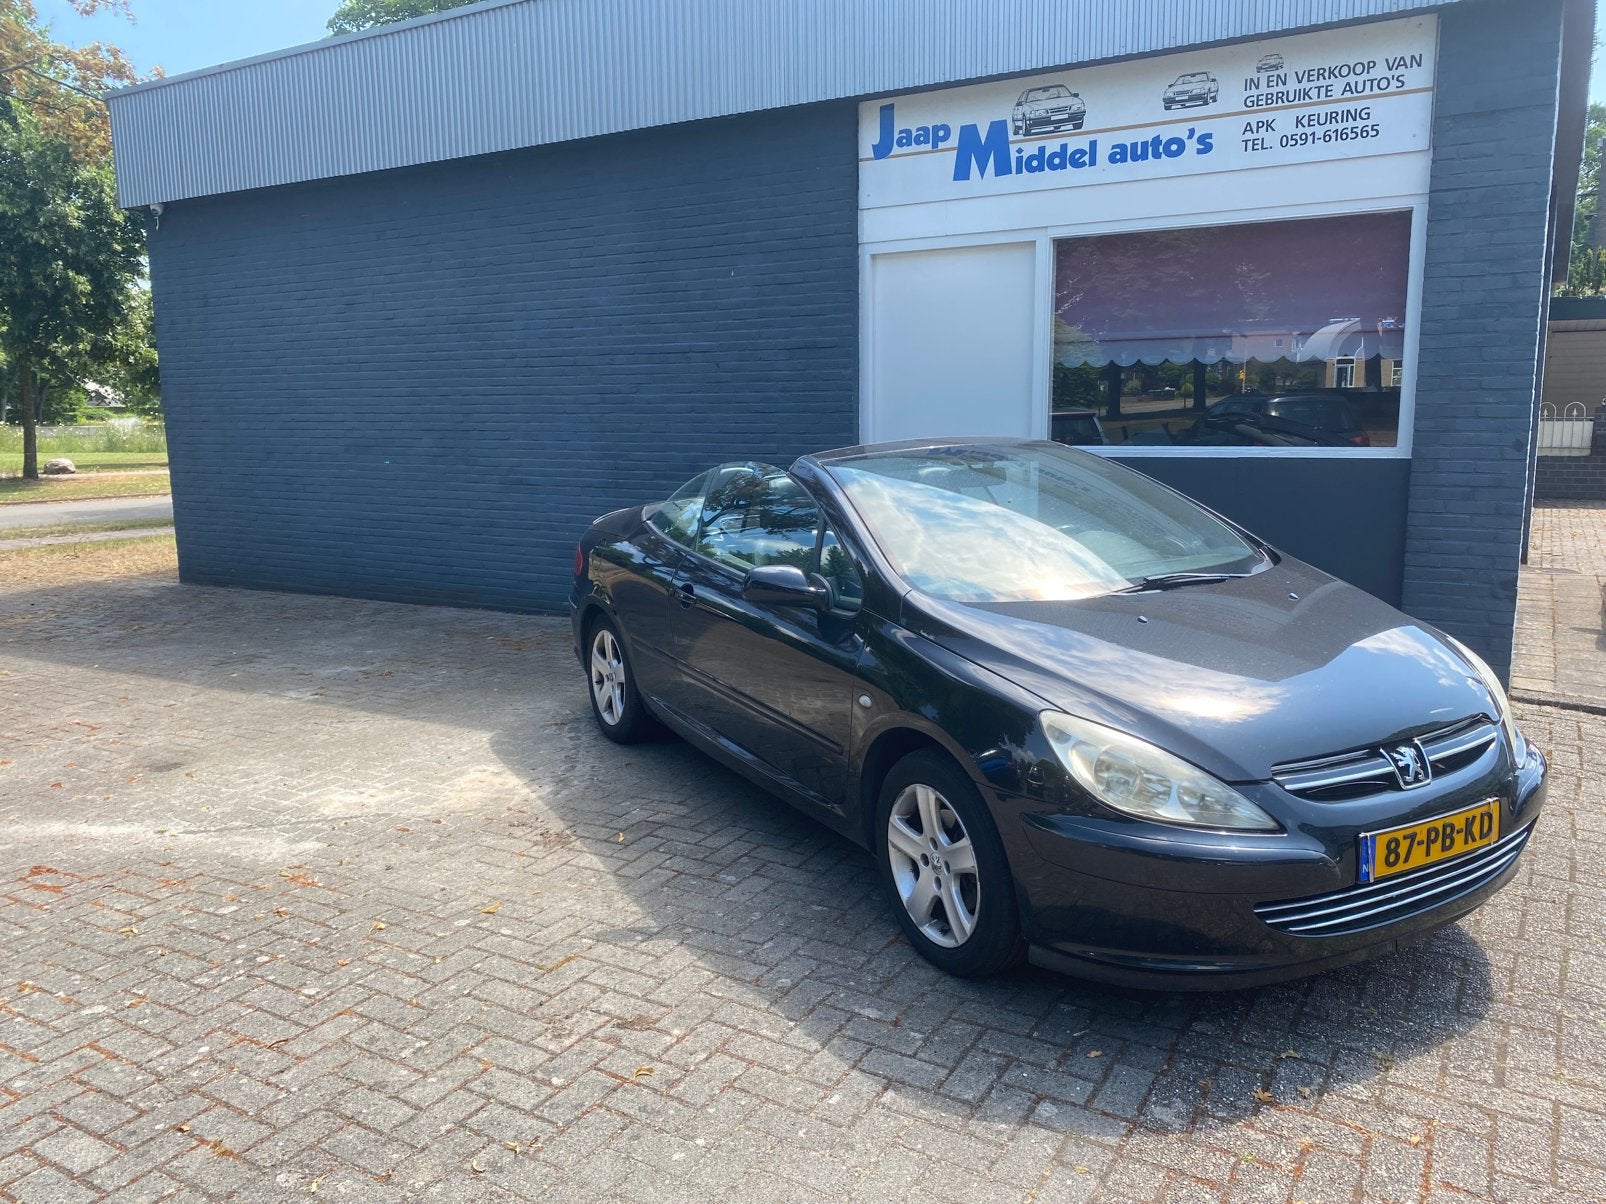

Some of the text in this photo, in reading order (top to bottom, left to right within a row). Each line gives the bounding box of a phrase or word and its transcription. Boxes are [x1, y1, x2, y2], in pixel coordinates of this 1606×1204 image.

[1243, 53, 1424, 92] IN EN VERKOOP VAN
[1243, 74, 1406, 109] GEBRUIKTE AUTO'S
[872, 103, 951, 161] Jaap
[1241, 106, 1371, 136] APK KEURING
[1241, 123, 1381, 153] TEL. 0591-616565
[952, 119, 1214, 182] Middel auto's
[1385, 811, 1493, 867] 87-PB-KD
